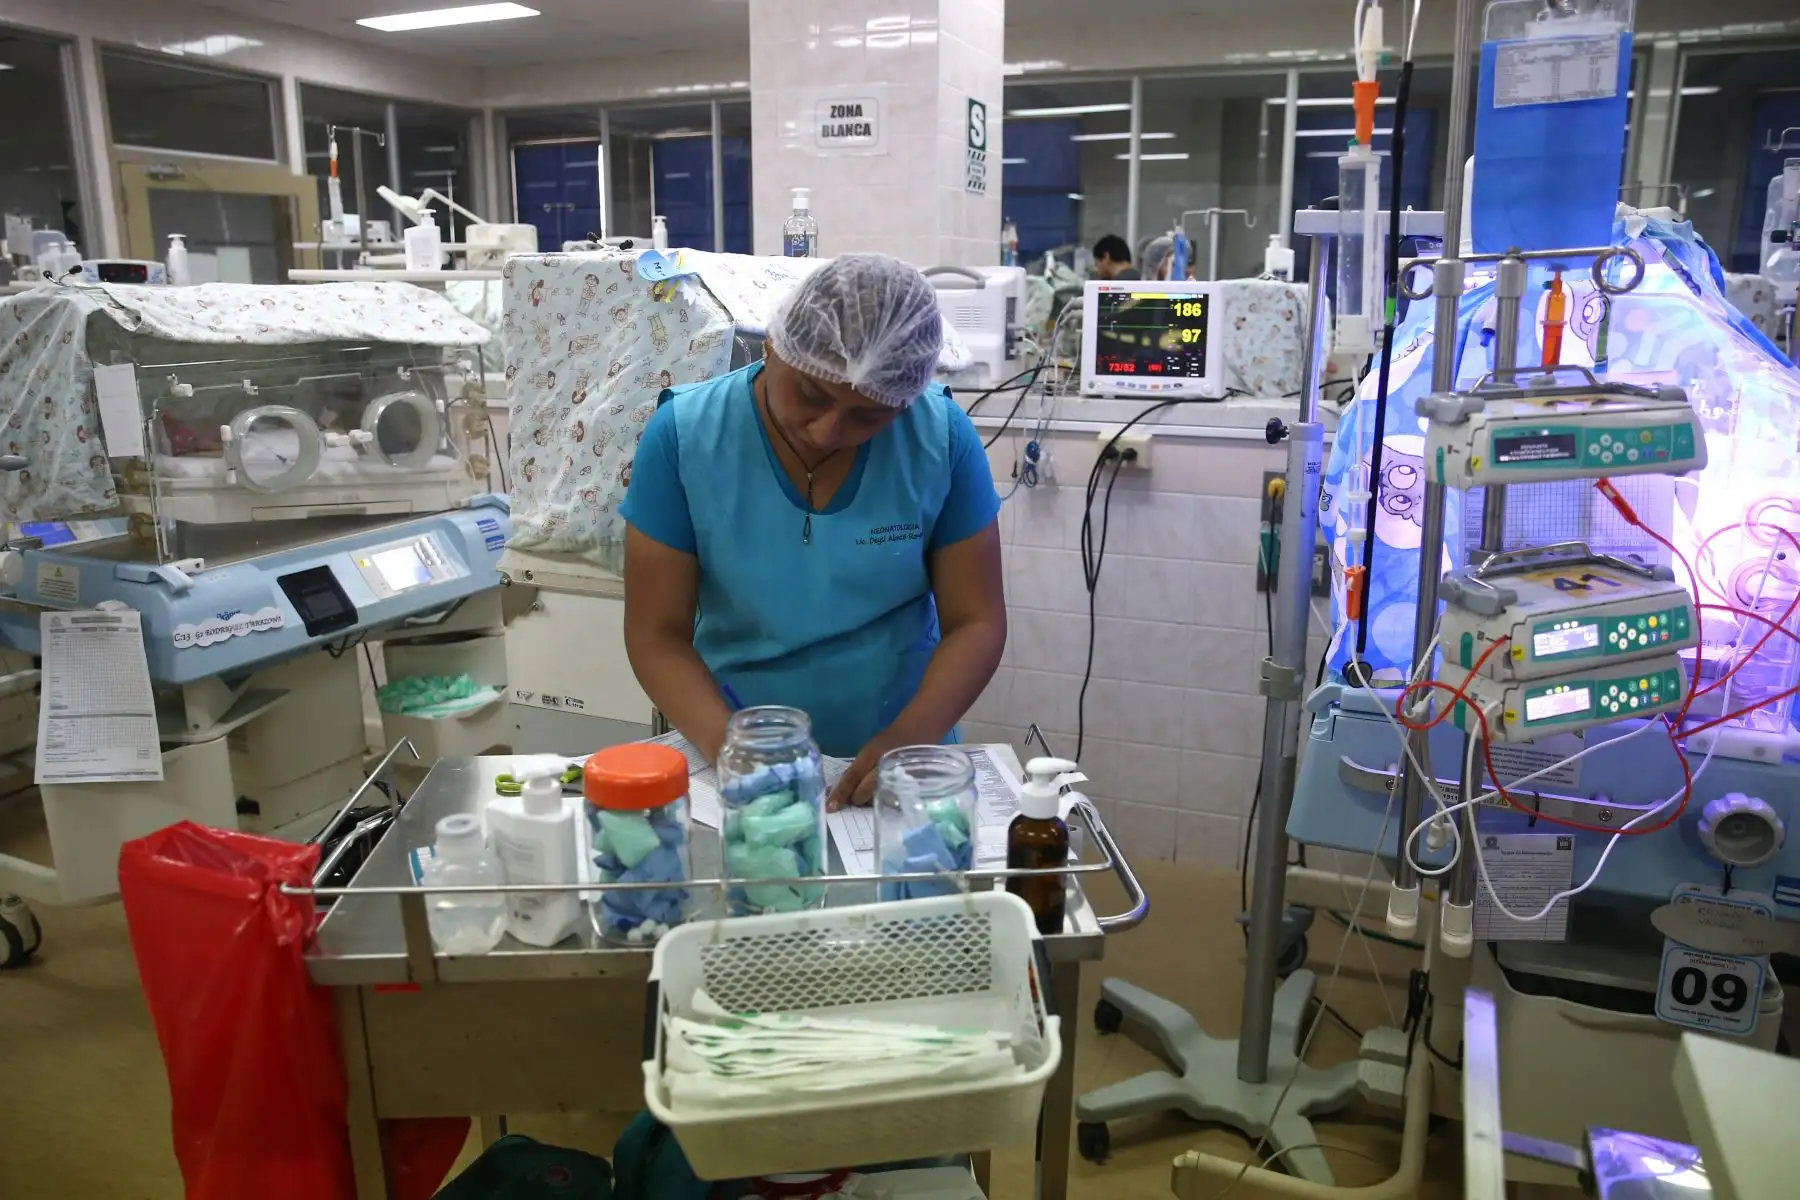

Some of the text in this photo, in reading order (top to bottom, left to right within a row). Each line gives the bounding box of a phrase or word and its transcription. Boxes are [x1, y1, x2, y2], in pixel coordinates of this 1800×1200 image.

[830, 104, 863, 118] ZONA
[821, 123, 872, 138] BLANCA
[970, 103, 985, 148] S
[1174, 302, 1202, 317] 186
[1181, 329, 1202, 343] 97
[1671, 967, 1748, 1013] 09
